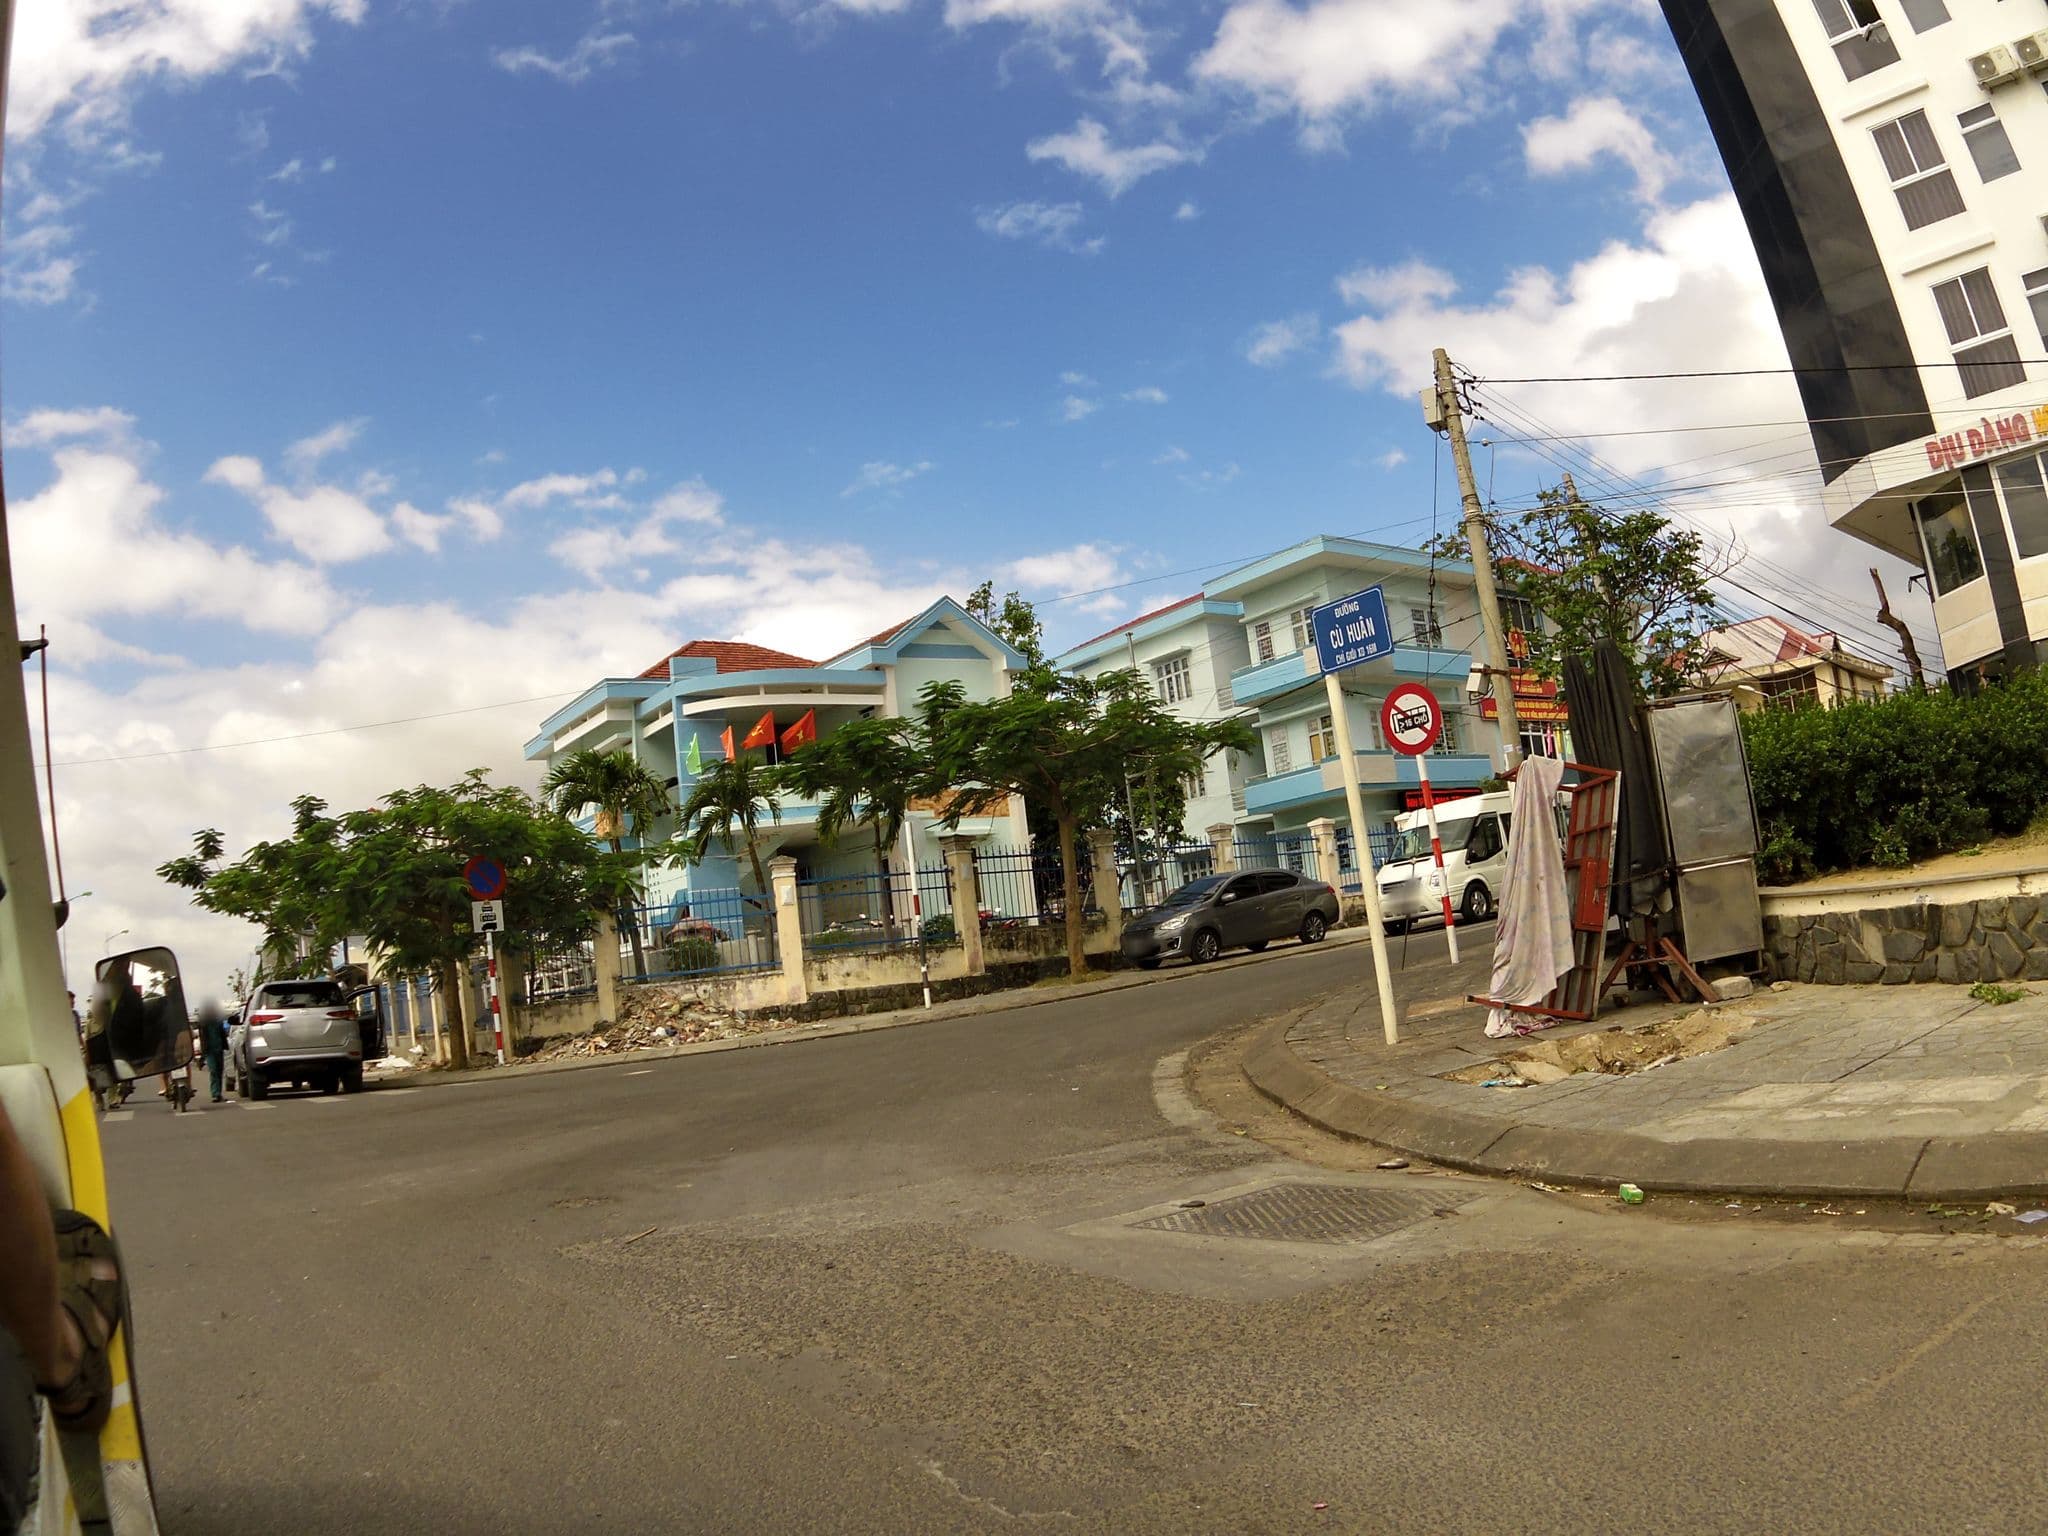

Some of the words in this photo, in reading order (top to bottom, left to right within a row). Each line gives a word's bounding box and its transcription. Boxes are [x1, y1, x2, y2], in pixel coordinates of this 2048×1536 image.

[1966, 413, 2032, 457] DÀNG
[1330, 624, 1344, 649] CÙ
[1346, 615, 1375, 643] HUÂN
